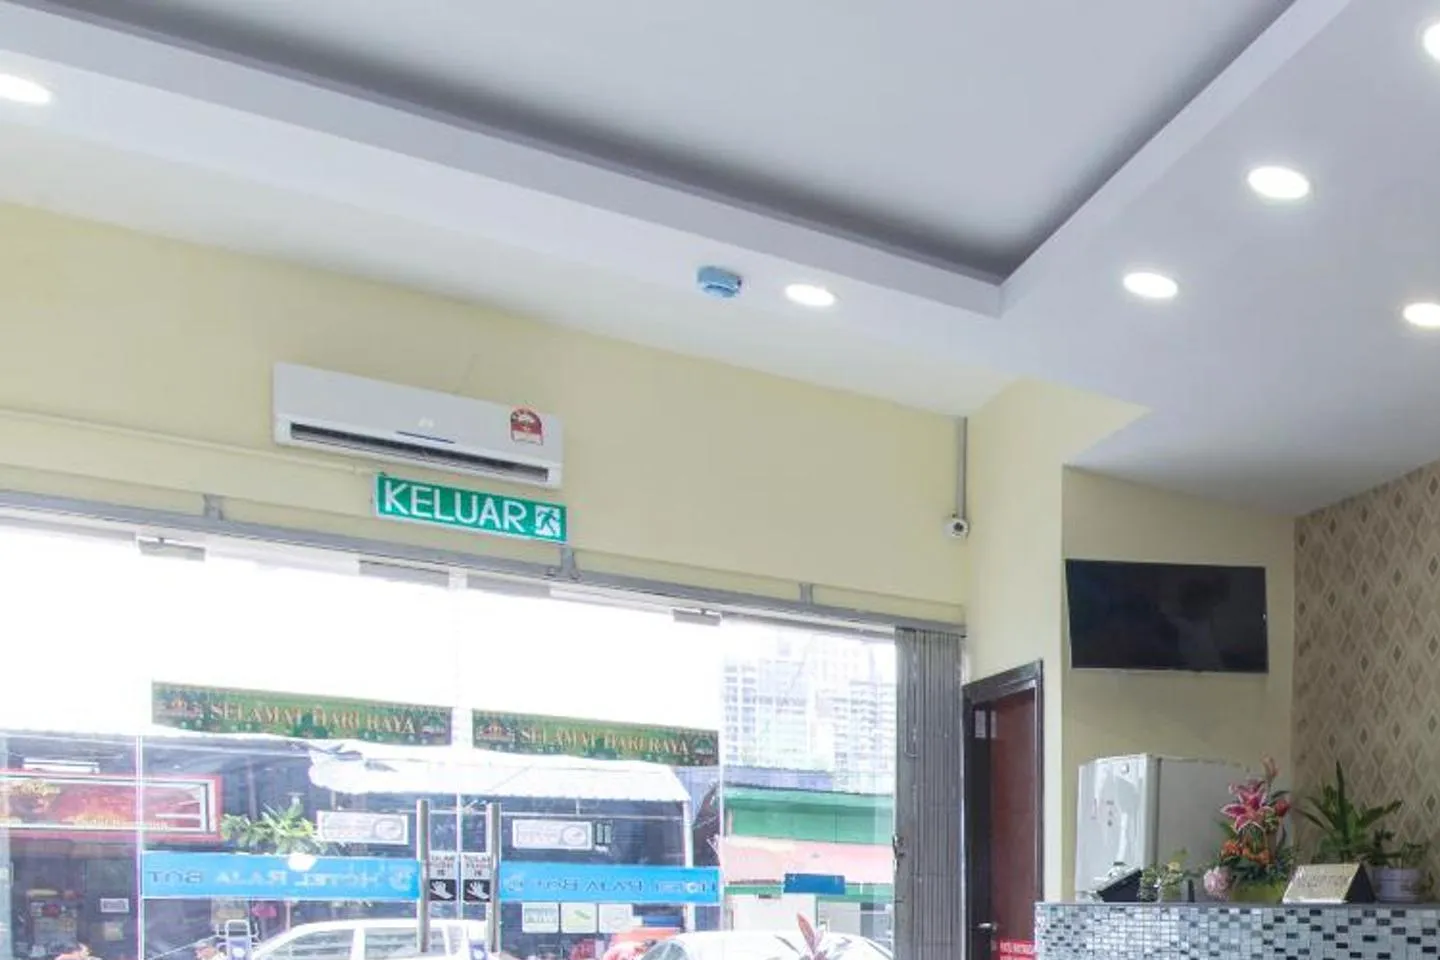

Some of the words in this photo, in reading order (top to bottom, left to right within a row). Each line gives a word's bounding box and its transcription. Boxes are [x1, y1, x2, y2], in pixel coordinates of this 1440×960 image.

[384, 480, 527, 533] KELUAR
[211, 704, 301, 726] SELAMAT
[366, 714, 416, 735] RAYA
[521, 727, 597, 748] SELAMAT
[649, 738, 690, 756] RAYA
